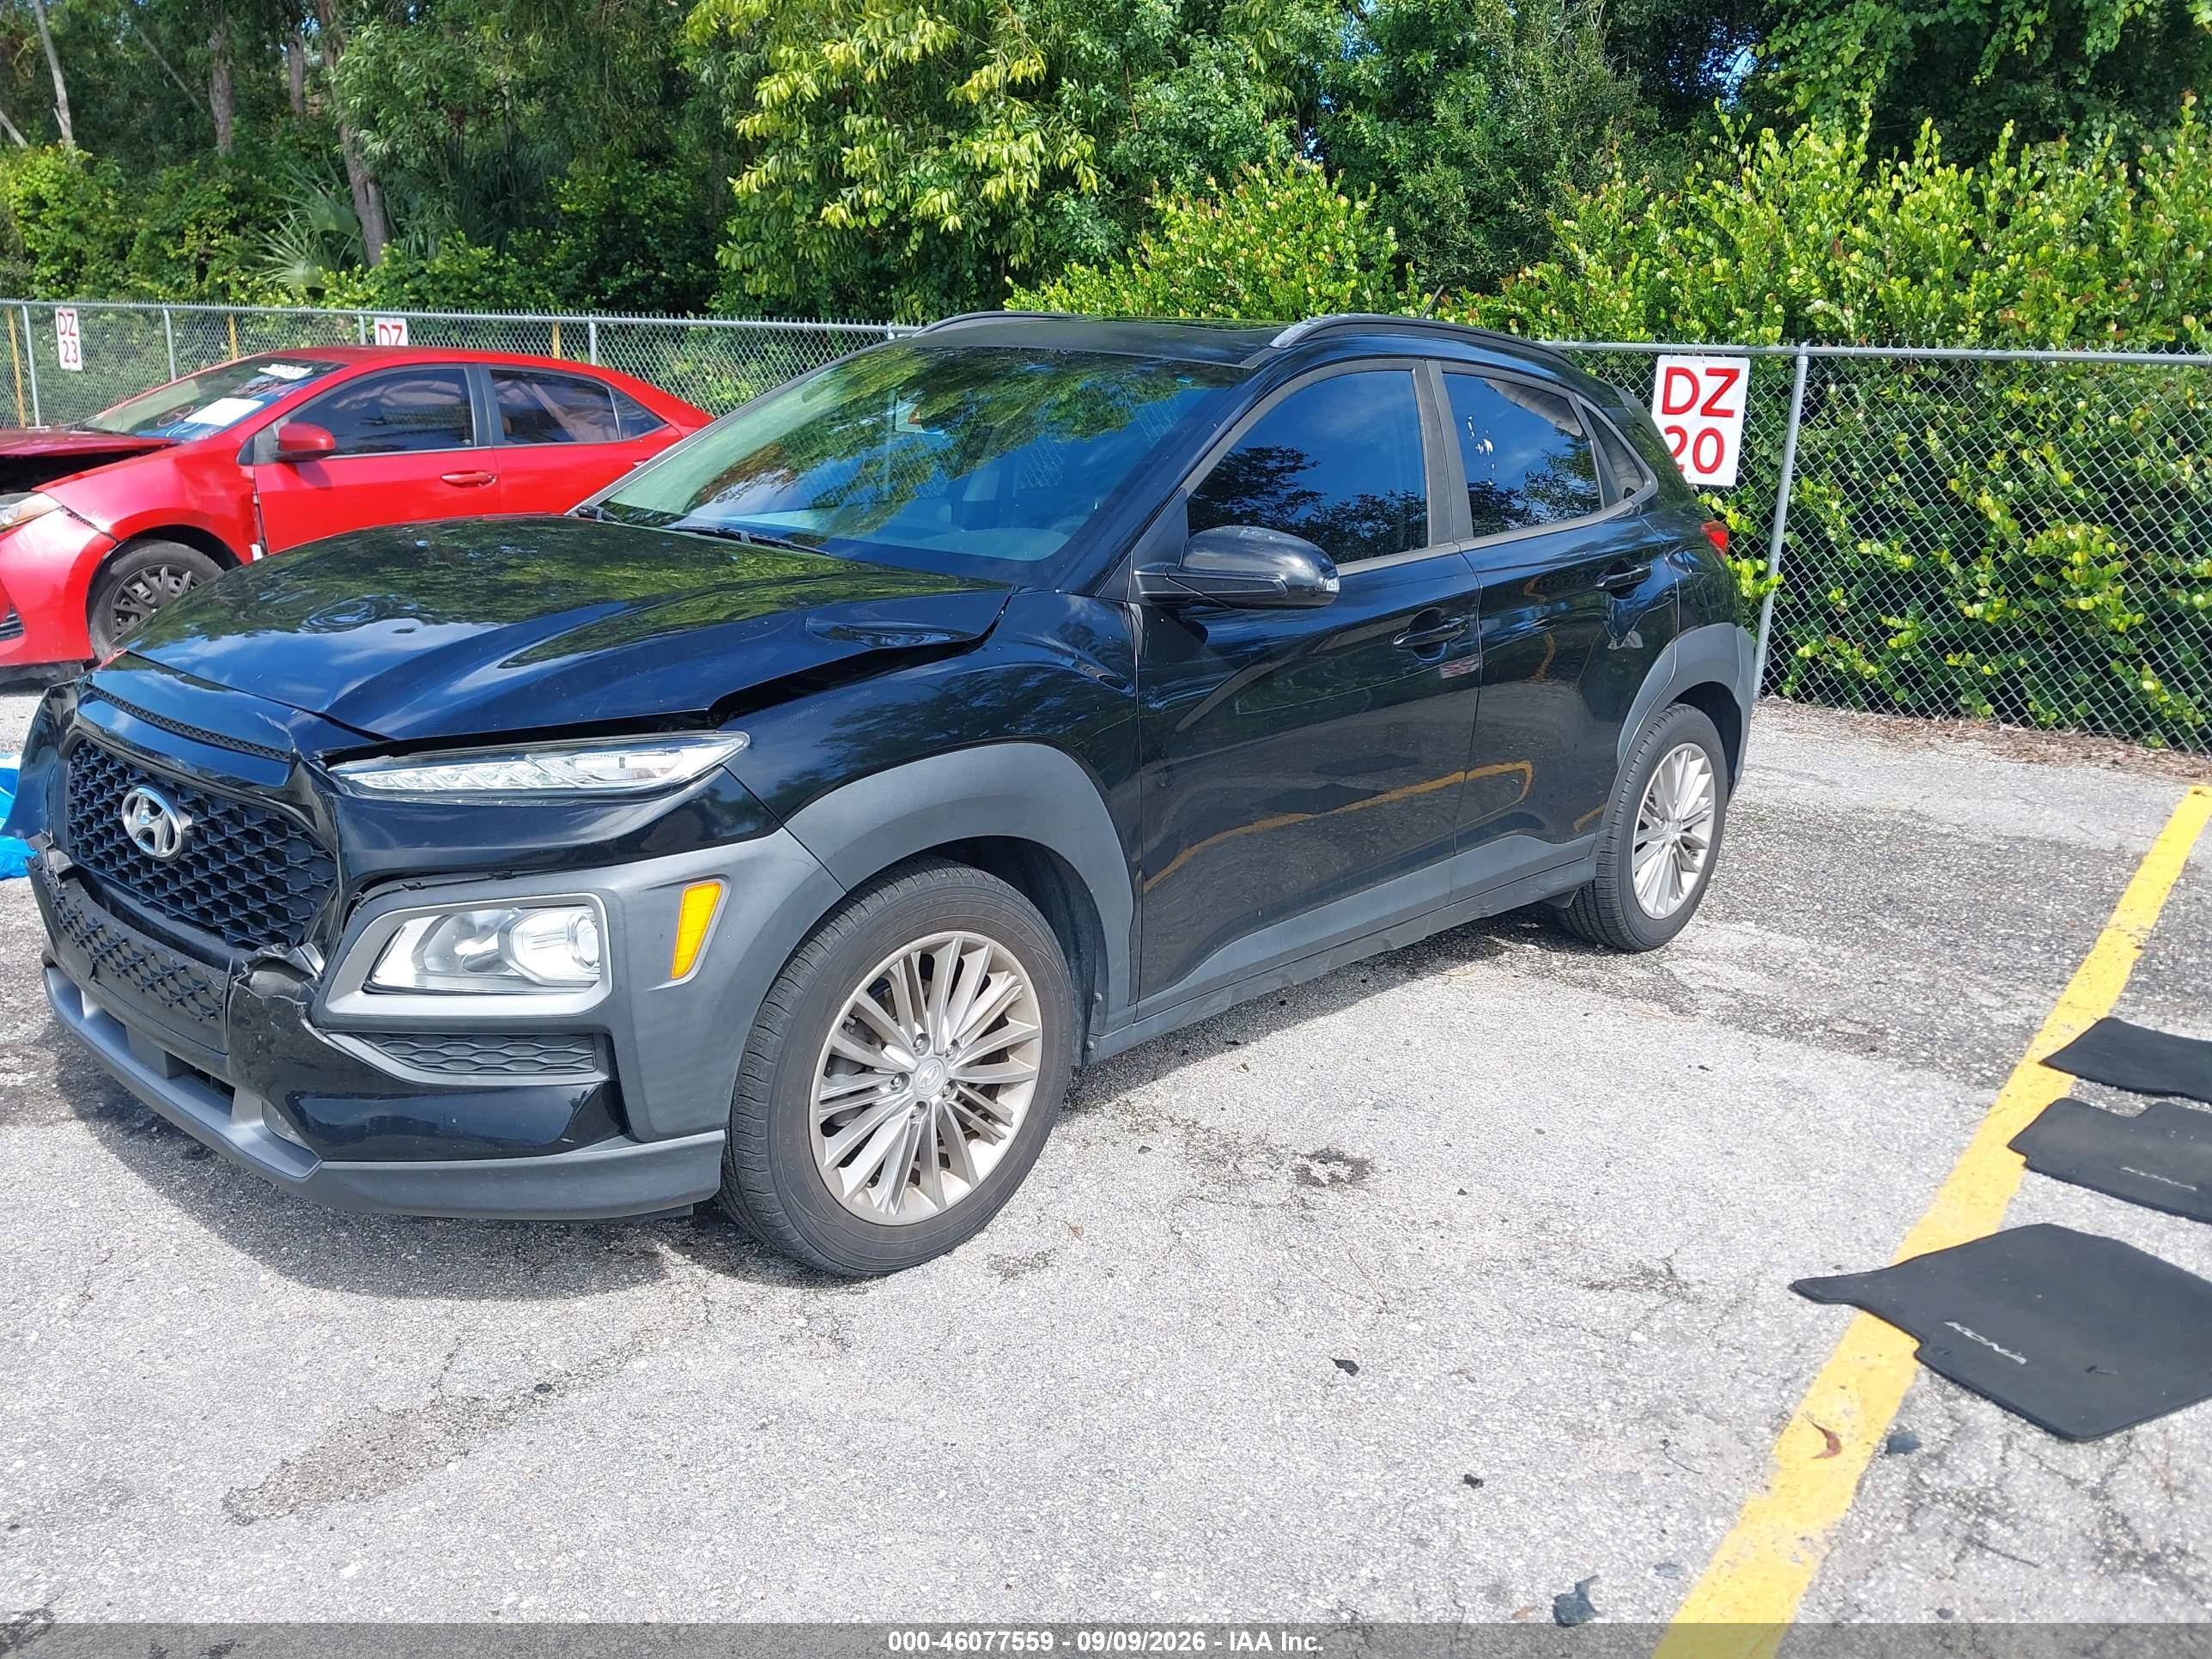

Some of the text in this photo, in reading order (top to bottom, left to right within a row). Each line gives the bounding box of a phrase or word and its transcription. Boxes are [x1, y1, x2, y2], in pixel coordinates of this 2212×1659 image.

[58, 311, 77, 337] DZ
[378, 323, 404, 346] DZ
[62, 339, 79, 364] 23
[1661, 366, 1741, 418] DZ
[1663, 424, 1725, 475] 20
